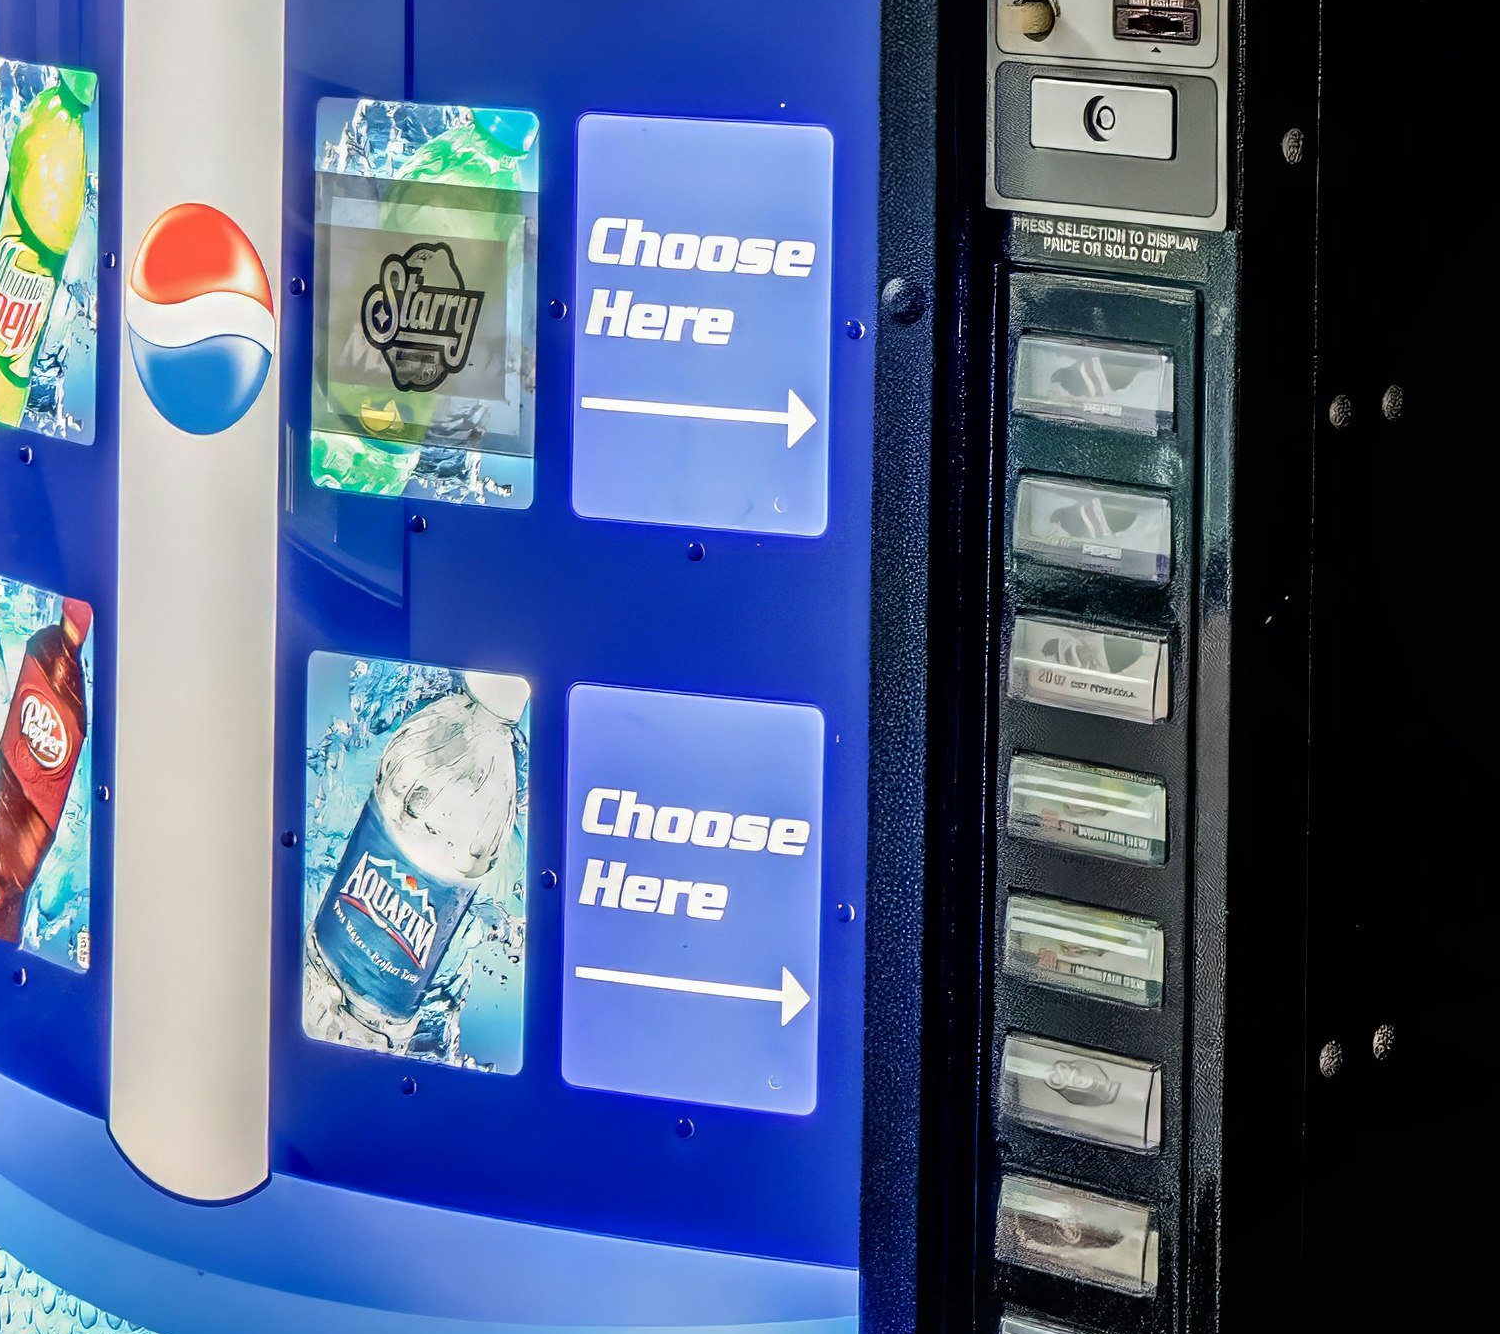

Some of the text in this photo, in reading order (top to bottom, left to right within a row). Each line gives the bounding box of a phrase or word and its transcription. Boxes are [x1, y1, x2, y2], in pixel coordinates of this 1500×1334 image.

[587, 217, 816, 277] Choose
[1012, 216, 1200, 252] PRESS SELECTION TO DISPLAY
[1043, 237, 1169, 265] PRICE OR SOLD OUT
[364, 257, 480, 369] Starry
[584, 288, 735, 346] Here
[580, 786, 810, 856] Choose
[578, 859, 729, 921] Here
